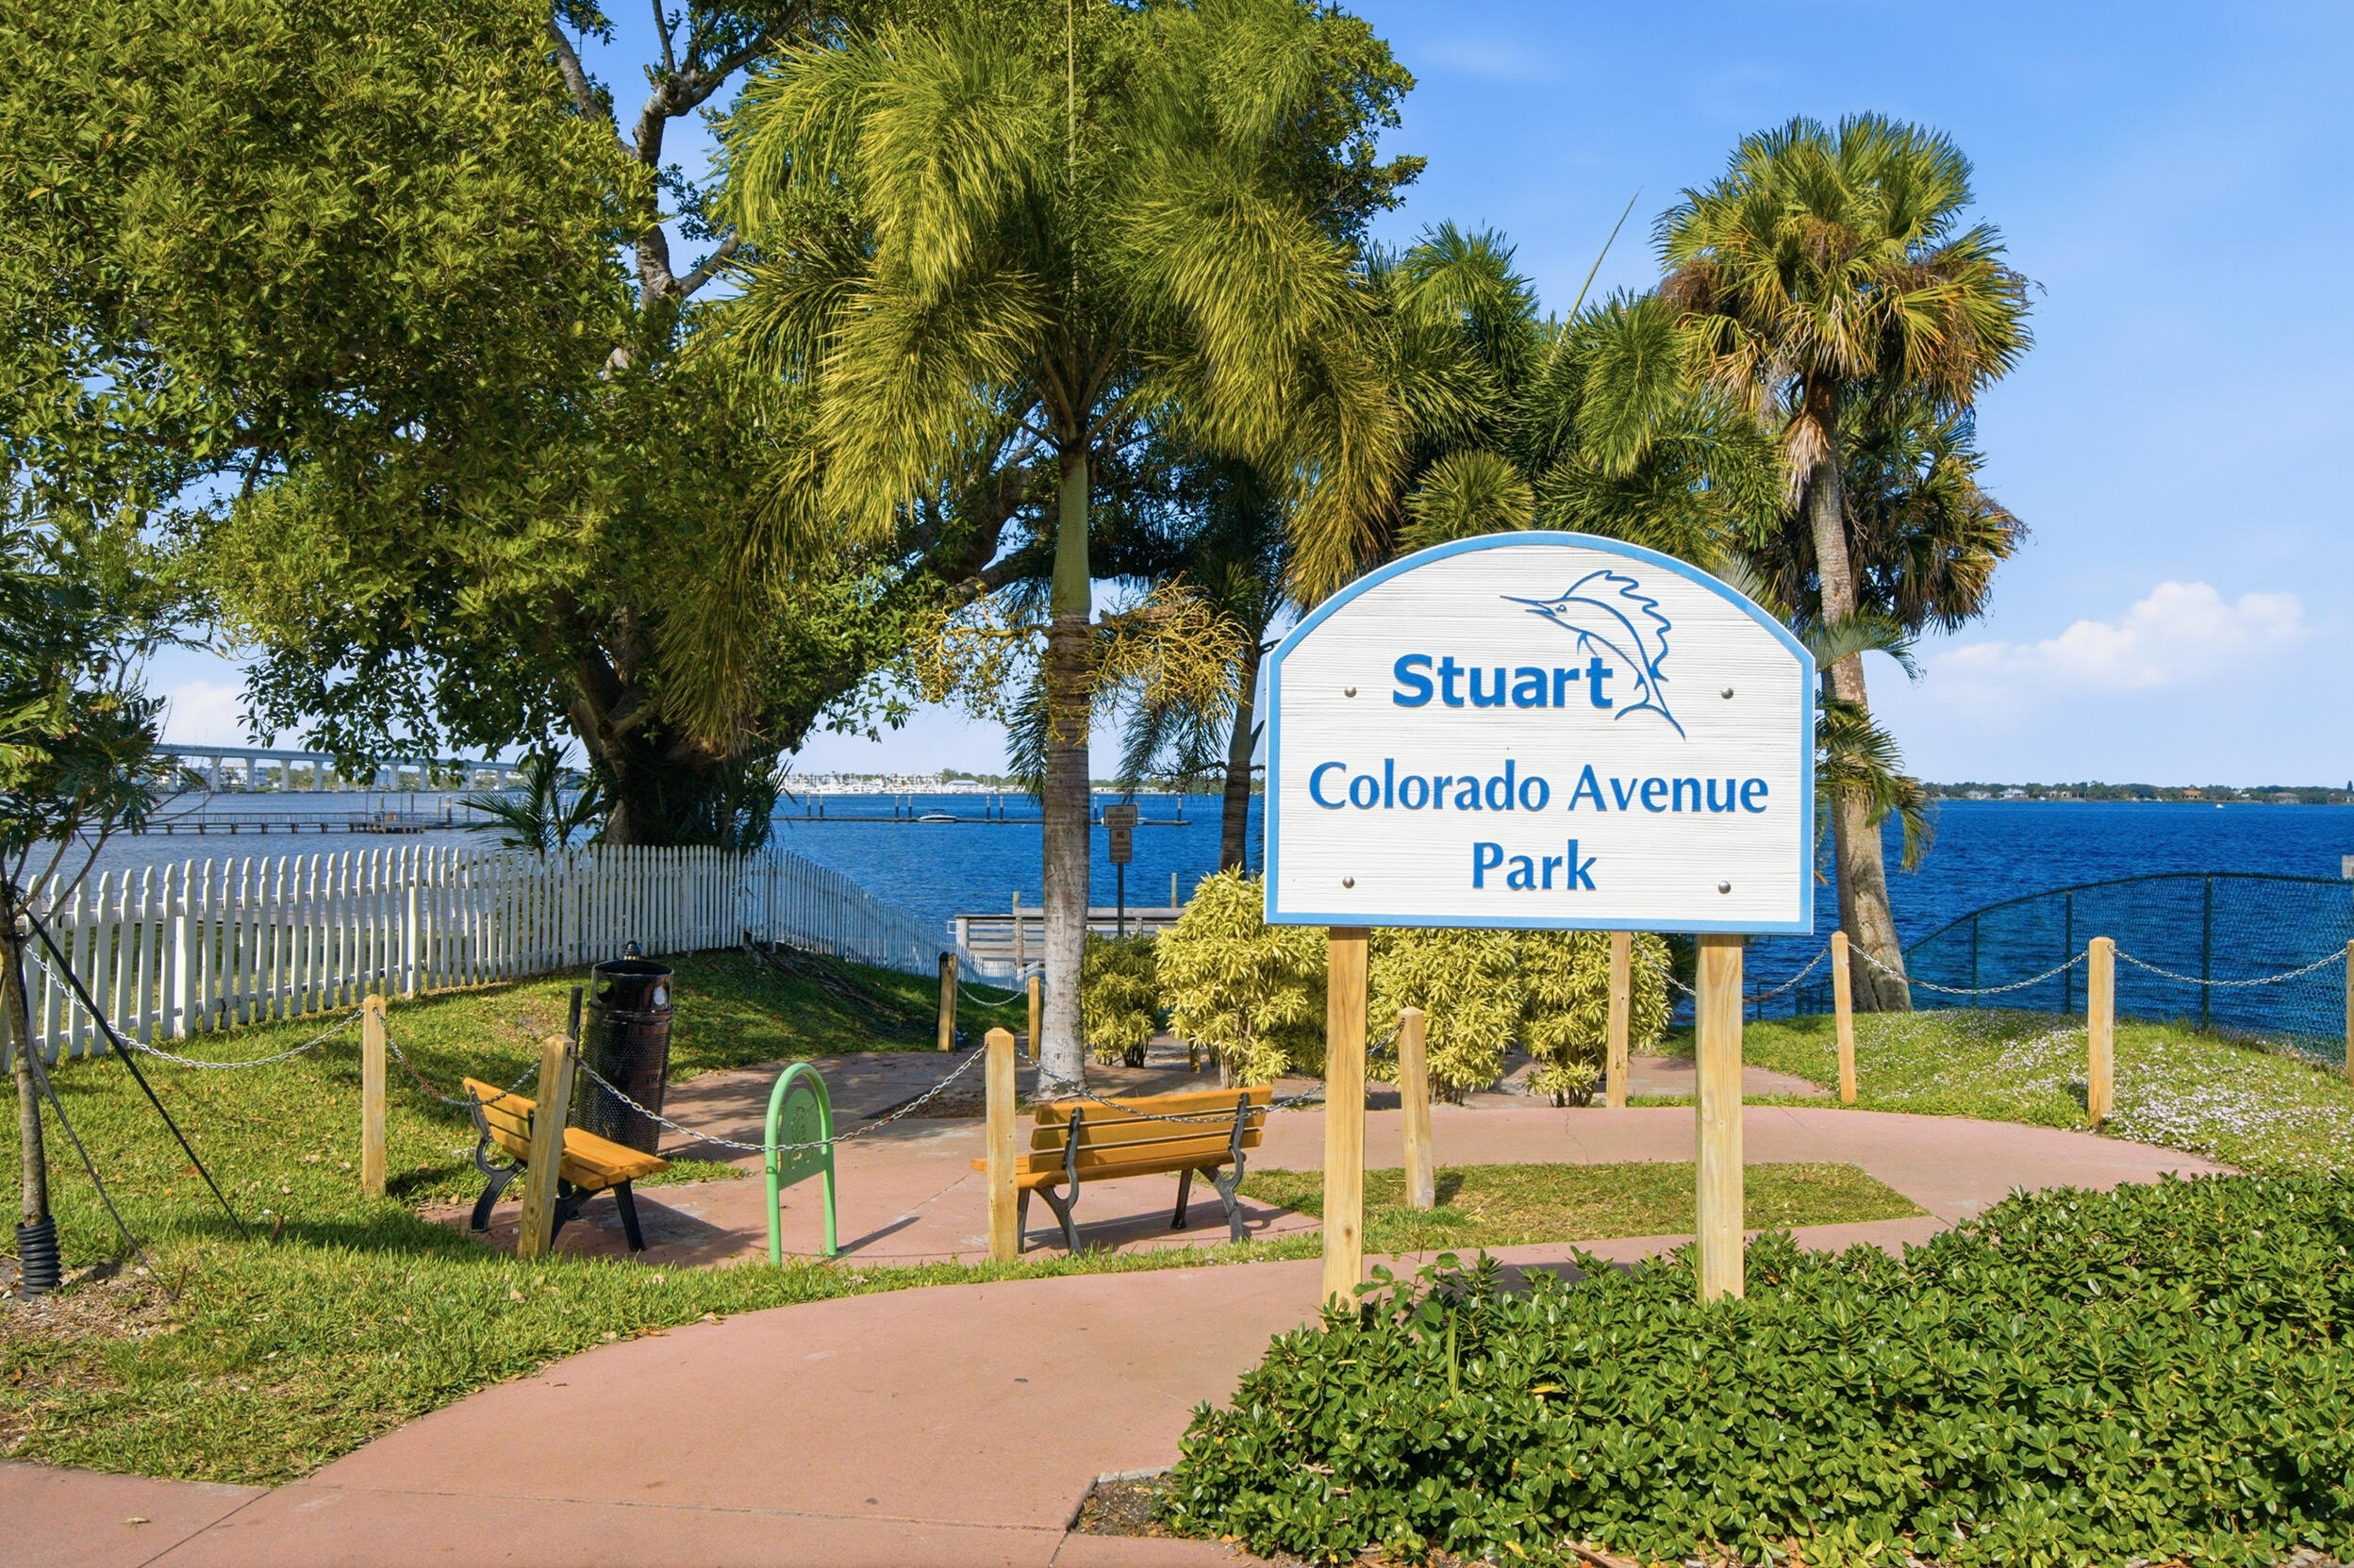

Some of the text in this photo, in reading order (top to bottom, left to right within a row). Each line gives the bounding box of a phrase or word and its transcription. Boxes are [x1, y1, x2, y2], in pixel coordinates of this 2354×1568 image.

[1392, 653, 1614, 708] Stuart
[1308, 758, 1769, 814] Colorado Avenue
[1471, 837, 1599, 891] Park
